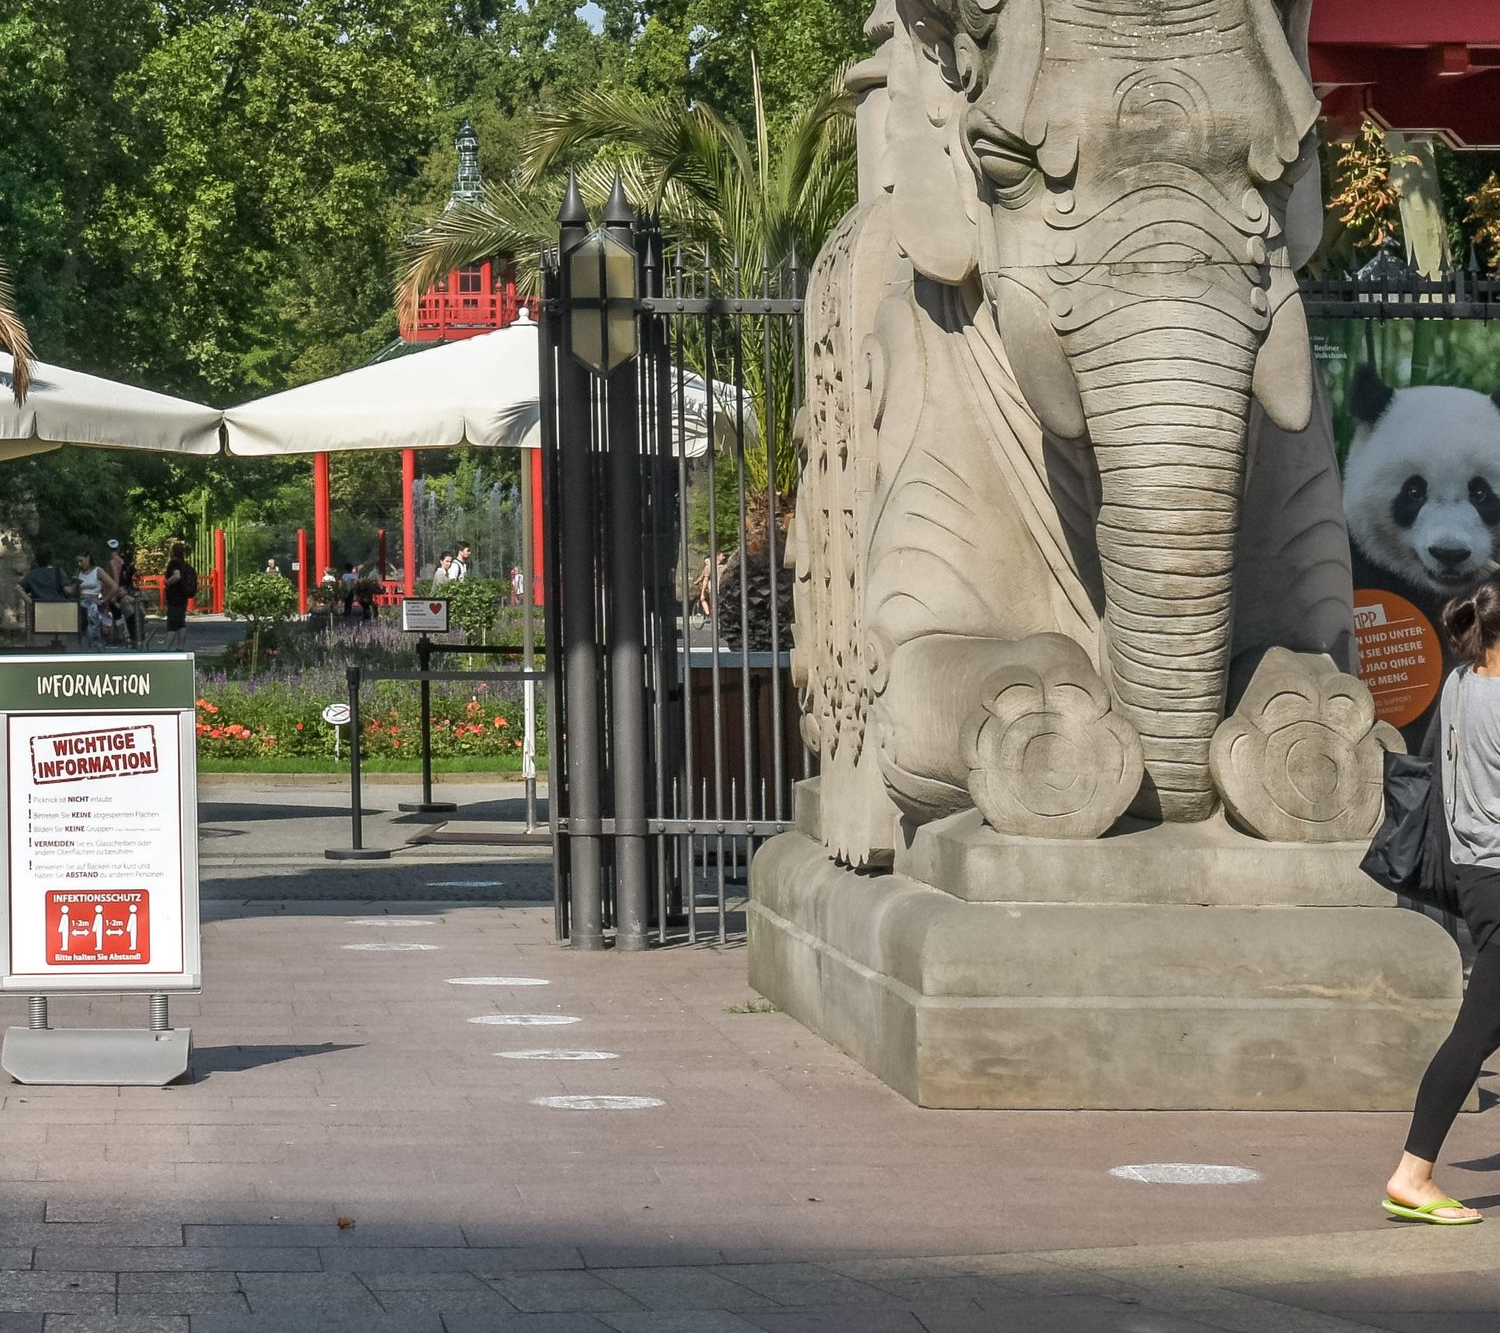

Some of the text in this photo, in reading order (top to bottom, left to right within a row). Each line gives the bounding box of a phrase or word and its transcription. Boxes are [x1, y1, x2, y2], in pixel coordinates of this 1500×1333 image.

[1314, 344, 1340, 352] Berliner
[1314, 351, 1348, 359] Volksbank
[1365, 632, 1388, 644] UND
[1389, 626, 1426, 640] UNTER-
[1367, 648, 1382, 659] SIE
[1383, 640, 1423, 656] UNSERE
[1366, 661, 1388, 673] JIAO
[1389, 656, 1416, 669] QING
[1417, 654, 1426, 664] &
[1378, 672, 1409, 686] MENG
[53, 733, 136, 757] WICHTIGE
[38, 751, 151, 779] INFORMATION
[90, 795, 112, 803] erlaubt
[71, 811, 92, 819] KEINE
[93, 812, 134, 820] abgesperrten
[135, 810, 160, 818] Flächen
[86, 825, 114, 833] Gruppen
[96, 839, 136, 847] Glasscheiben
[34, 848, 55, 856] andere
[34, 871, 53, 879] halten
[135, 870, 164, 878] Personen
[53, 893, 142, 903] INFEKTIONSSCHUTZ
[71, 919, 124, 927] 1-2m 1-2m
[55, 952, 142, 961] Bitte halten Sie Abstand!
